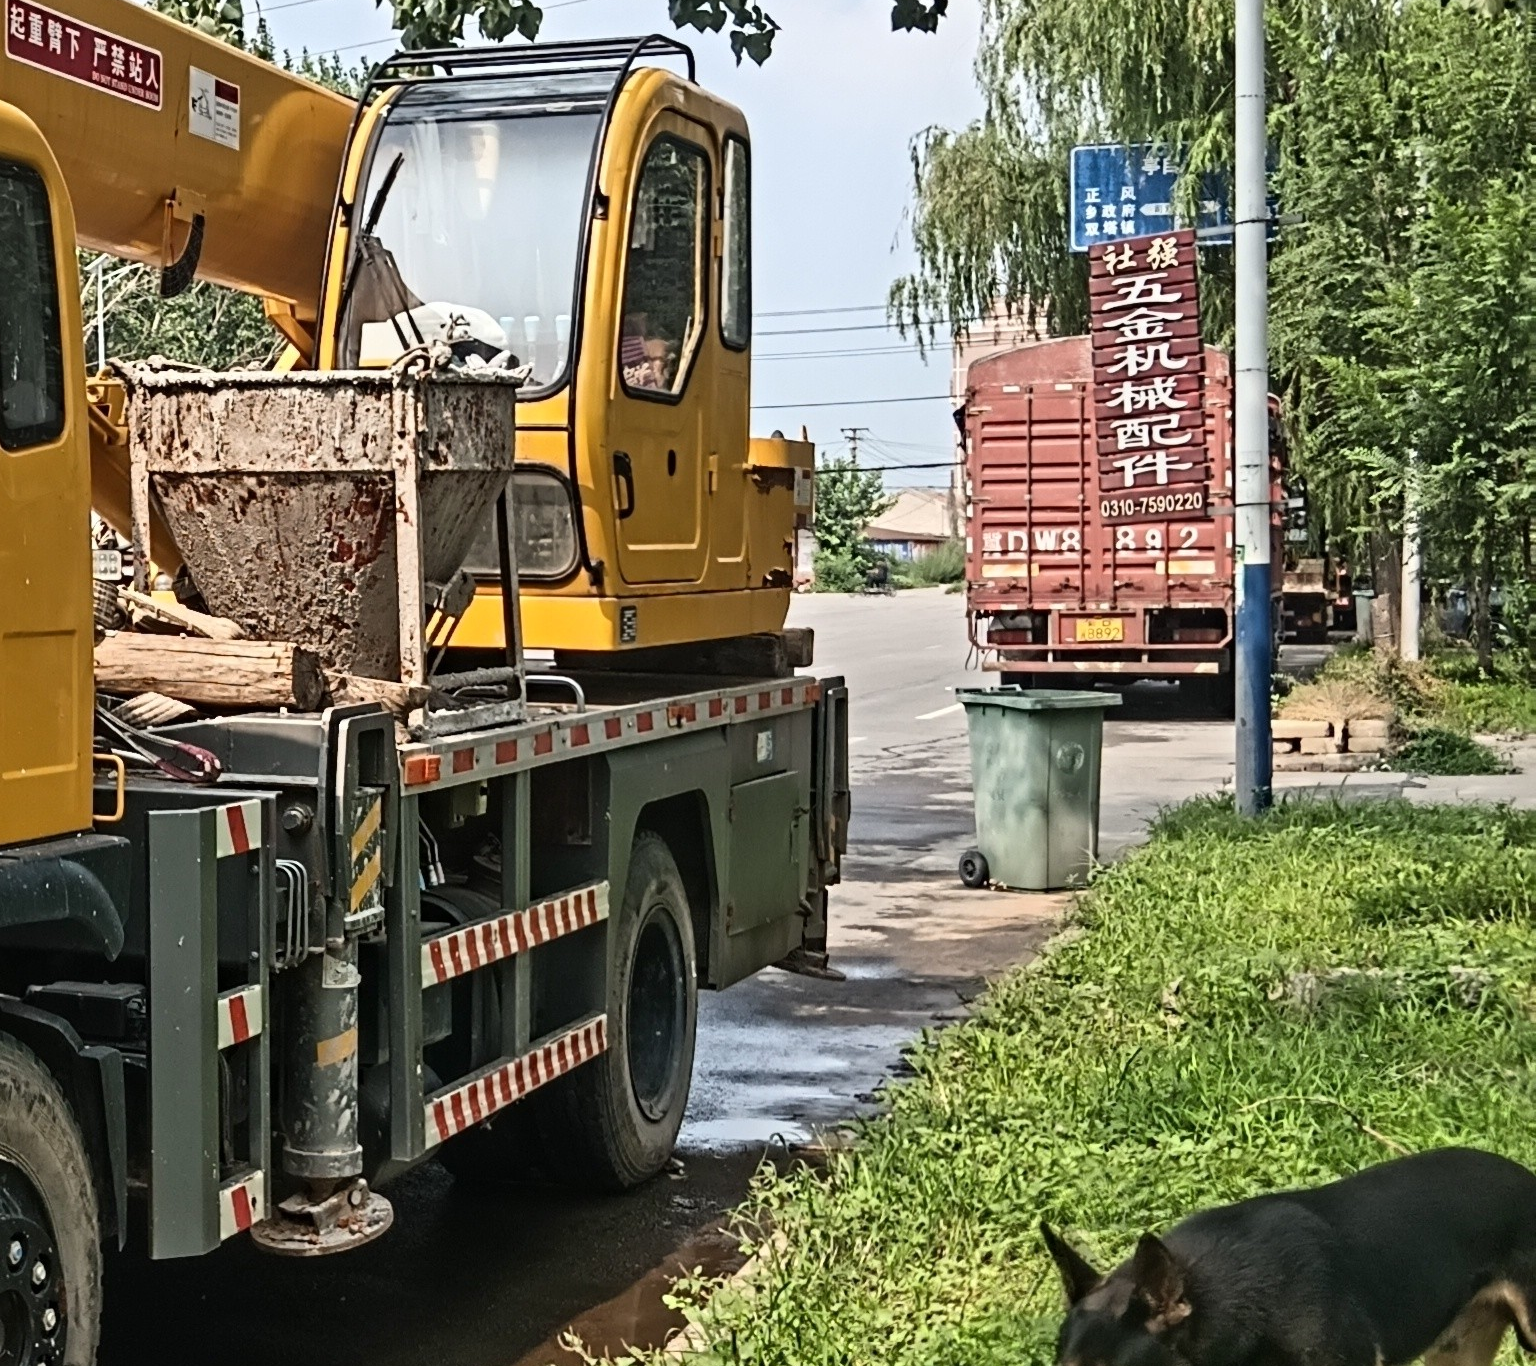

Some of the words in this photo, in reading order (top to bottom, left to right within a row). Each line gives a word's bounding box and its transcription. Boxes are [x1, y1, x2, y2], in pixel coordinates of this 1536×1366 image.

[9, 3, 81, 60] 起重臂下
[92, 36, 159, 90] 严禁站人
[1102, 236, 1179, 276] 社强
[1101, 272, 1194, 487] 五金机械配件
[1100, 492, 1203, 518] 0310-7590220
